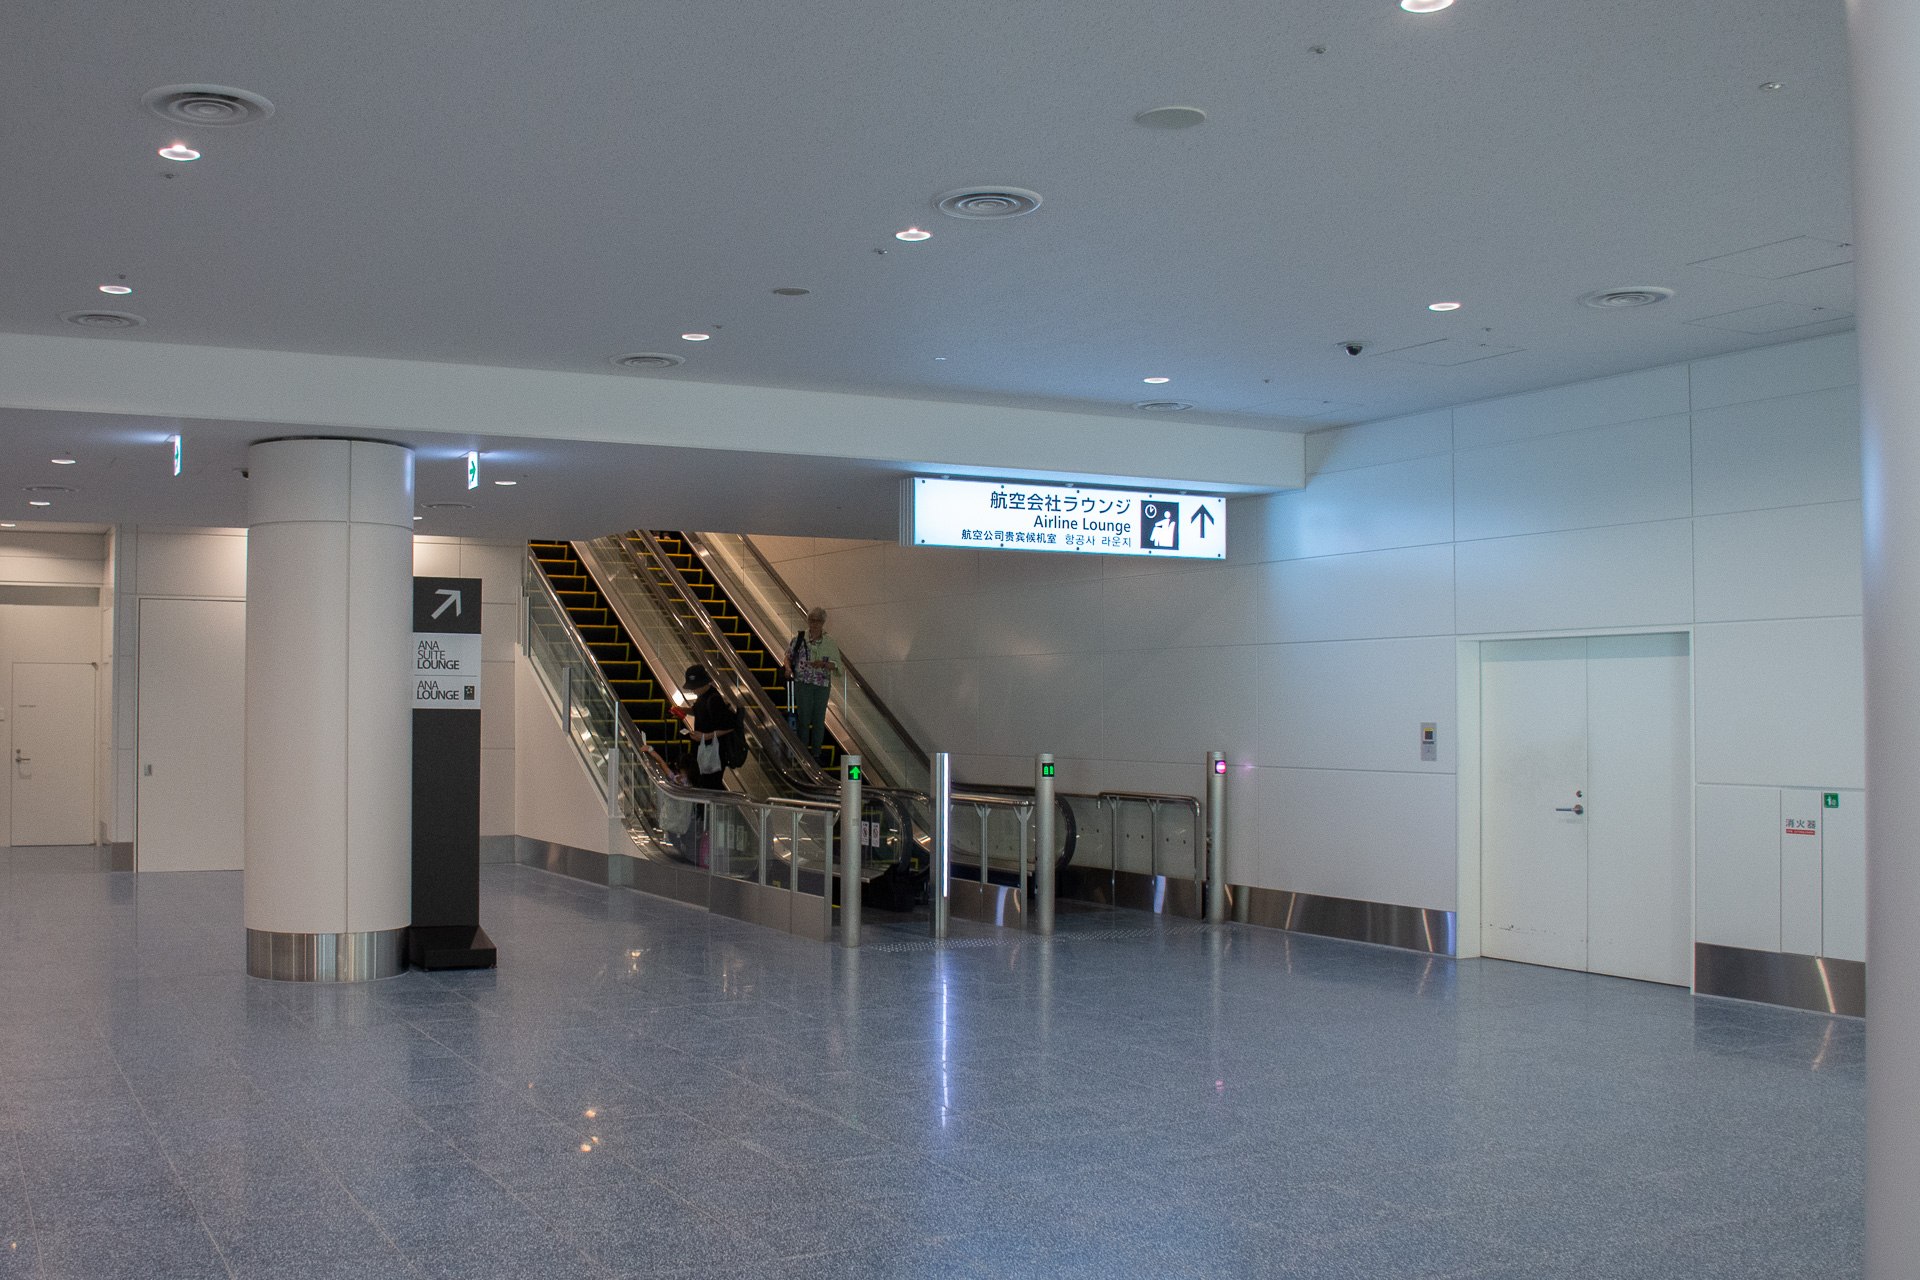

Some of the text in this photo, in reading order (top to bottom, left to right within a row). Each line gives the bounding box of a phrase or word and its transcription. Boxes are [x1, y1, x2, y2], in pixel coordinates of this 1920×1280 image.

[990, 491, 1131, 515] 航空会社ラウンジ
[1033, 515, 1131, 535] Airline Lounge
[961, 529, 1057, 544] 航空公司贵宾候机室
[1065, 533, 1131, 548] 항공사 라운지
[417, 640, 440, 650] ANA
[417, 650, 446, 660] SUITE
[417, 659, 460, 670] LOUNGE
[417, 680, 439, 690] ANA
[416, 689, 460, 700] LOUNGE
[1785, 818, 1816, 829] 消火器
